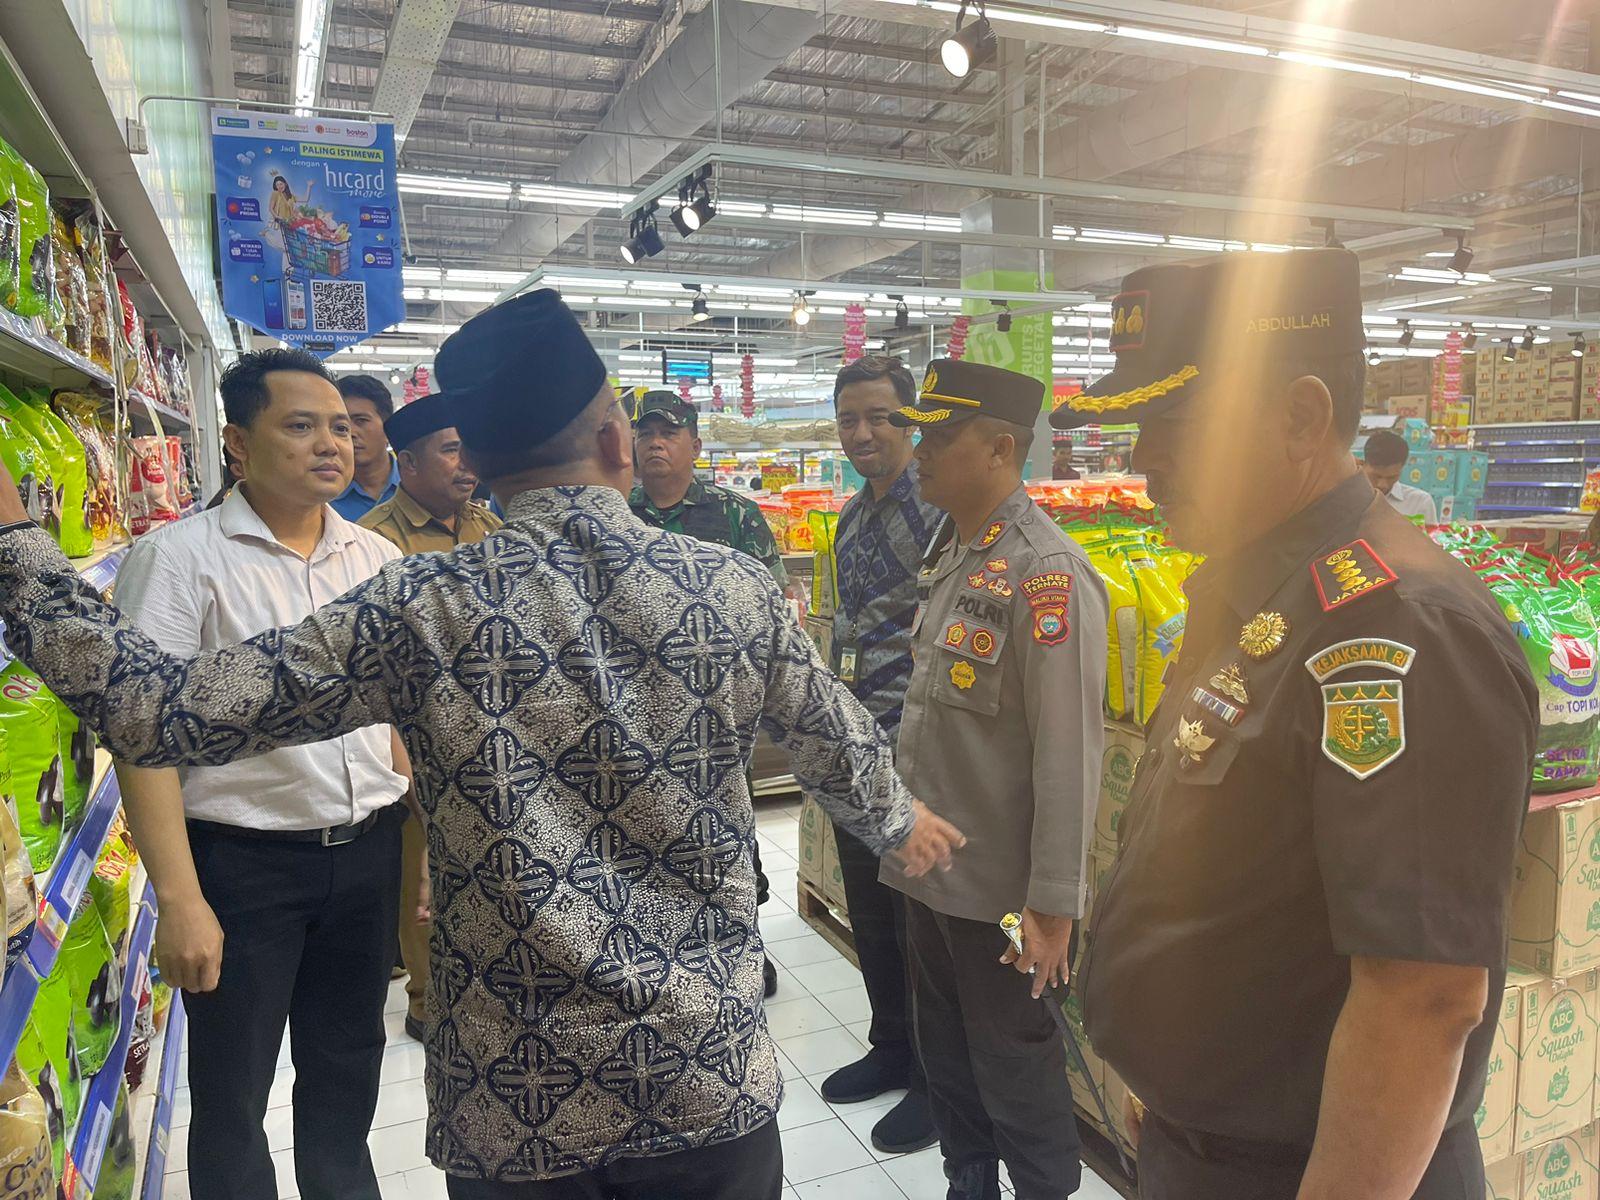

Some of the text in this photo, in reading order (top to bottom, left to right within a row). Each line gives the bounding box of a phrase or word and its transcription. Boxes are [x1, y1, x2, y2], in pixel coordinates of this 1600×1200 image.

[280, 145, 382, 160] Jadi PALING ISTIMEWA
[291, 160, 320, 169] dengan
[324, 163, 385, 190] hicard
[1246, 312, 1331, 333] ABDULLAH
[281, 333, 334, 342] DOWNLOAD
[1022, 323, 1033, 376] RUITS
[1023, 574, 1069, 590] POLRES
[1026, 580, 1069, 594] TERNATE
[1331, 576, 1386, 604] JAKSA
[955, 595, 1004, 624] POLRI
[1313, 642, 1409, 675] KEJAKSAAN RI
[1567, 700, 1588, 713] TOPI
[1101, 773, 1129, 798] Squa
[1551, 1009, 1573, 1030] ABC
[1537, 1026, 1584, 1062] Squash
[1548, 1155, 1568, 1173] ABC
[1537, 1170, 1583, 1199] Squash
